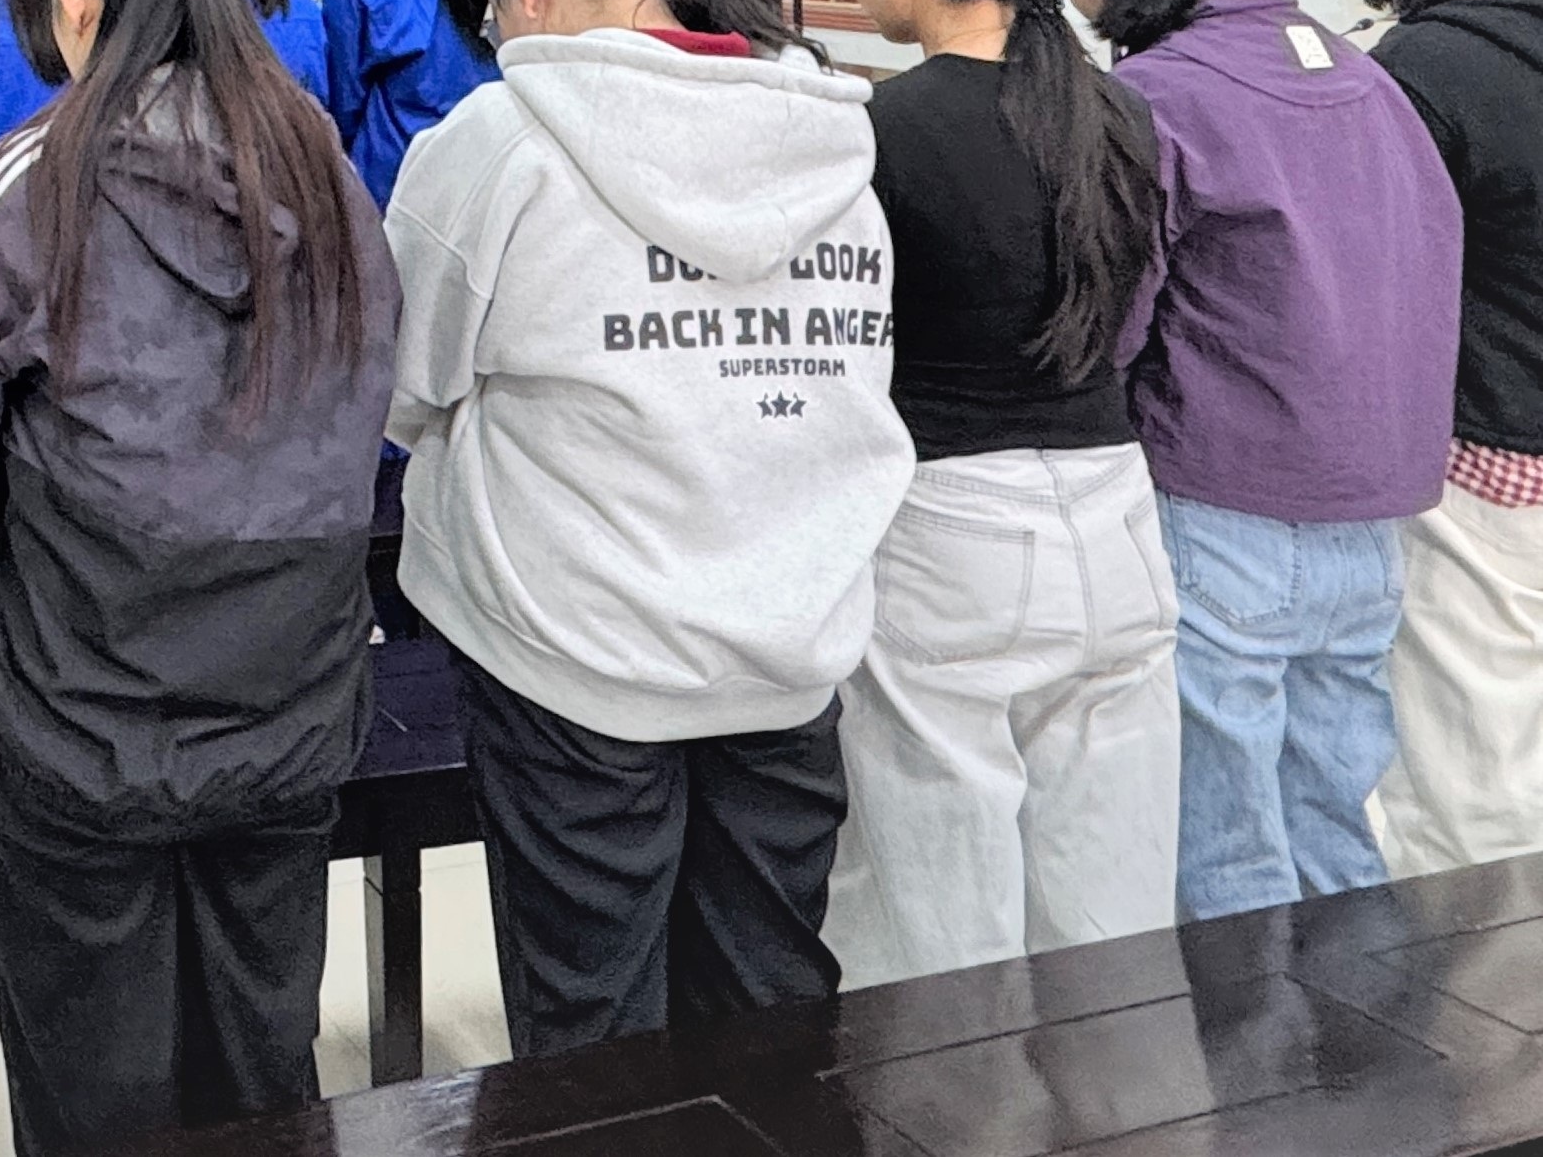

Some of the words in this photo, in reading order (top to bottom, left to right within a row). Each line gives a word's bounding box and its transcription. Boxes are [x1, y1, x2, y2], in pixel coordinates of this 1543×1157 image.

[790, 242, 882, 285] LOOK
[603, 308, 724, 351] BACK
[735, 307, 791, 346] IN
[719, 358, 846, 377] SUPERSTORM
